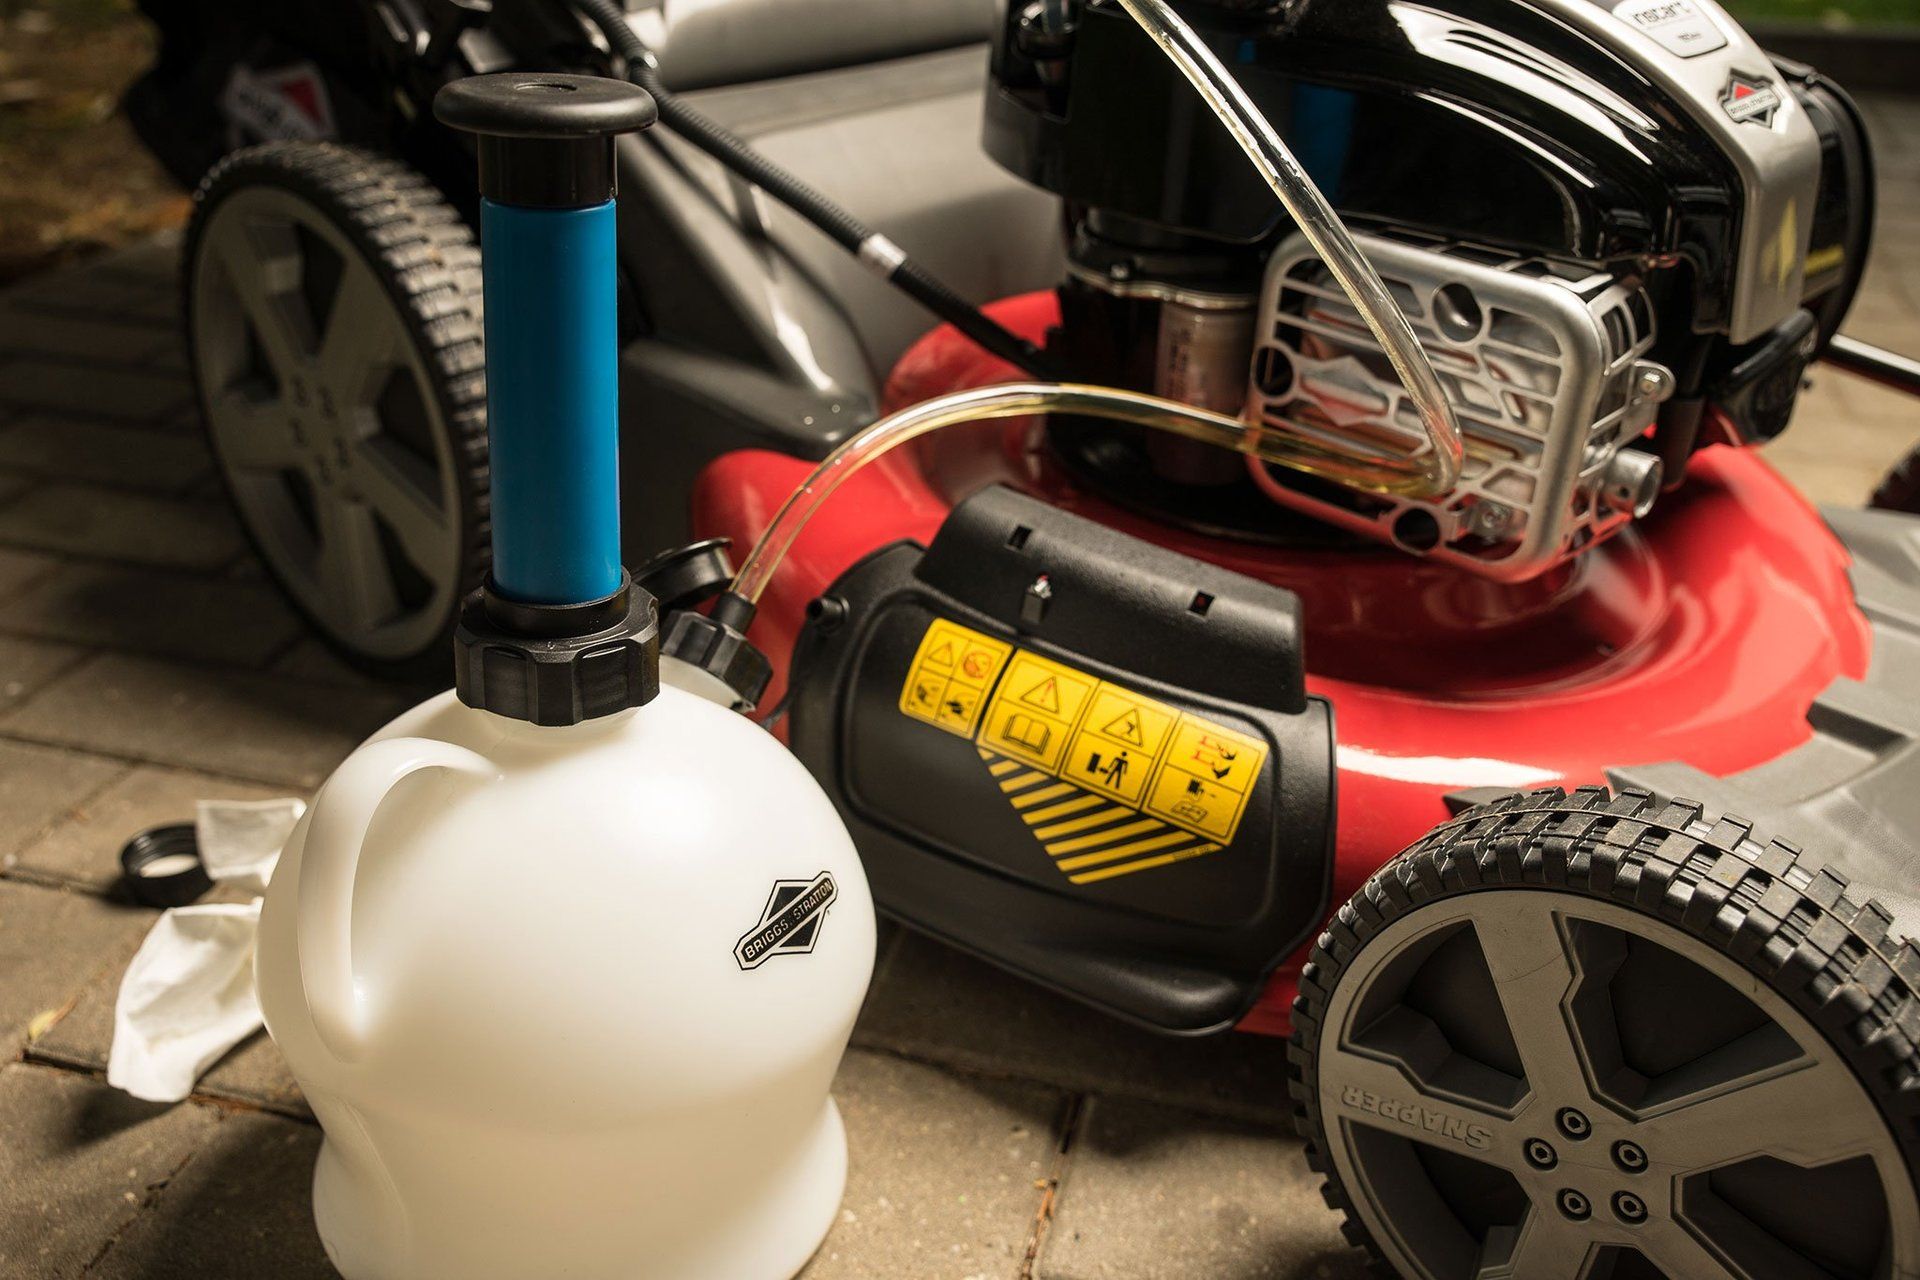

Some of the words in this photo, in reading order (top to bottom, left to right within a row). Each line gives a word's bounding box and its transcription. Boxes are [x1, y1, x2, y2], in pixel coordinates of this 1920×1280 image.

[744, 919, 789, 959] BRIGGS
[792, 880, 833, 920] STRATTON
[1341, 1084, 1491, 1150] SNAPPER
